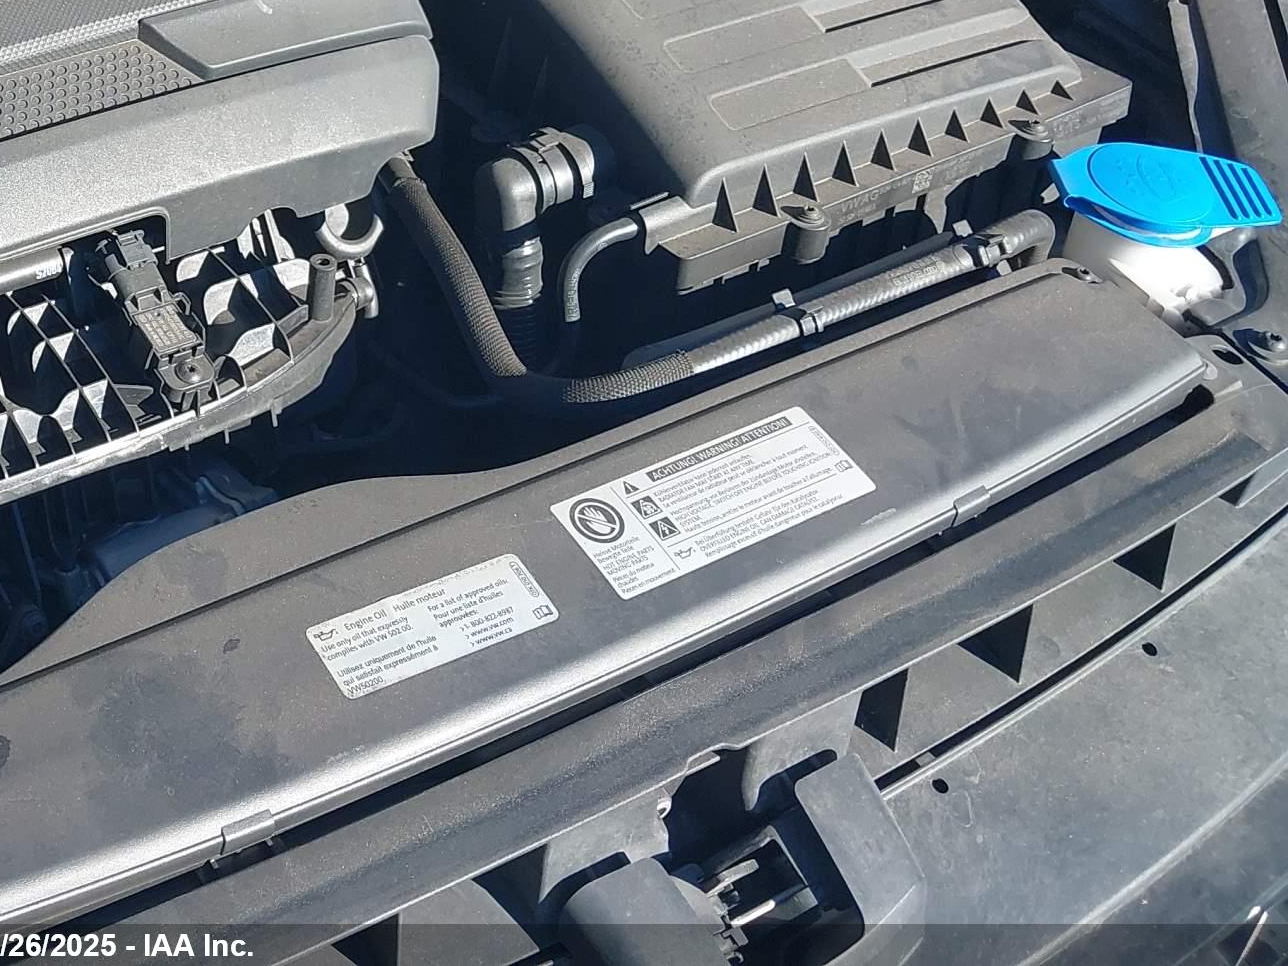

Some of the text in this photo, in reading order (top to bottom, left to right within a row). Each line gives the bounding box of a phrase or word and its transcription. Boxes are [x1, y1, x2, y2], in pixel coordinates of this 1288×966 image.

[697, 440, 741, 461] WARNING!
[742, 420, 788, 443] ATTENTION!
[465, 584, 494, 599] approved
[344, 617, 373, 630] Engine
[374, 610, 387, 619] Oil
[416, 590, 445, 603] moteur
[434, 611, 449, 620] Pour
[321, 644, 336, 652] Use
[337, 639, 351, 647] only
[352, 633, 361, 641] oil
[361, 628, 377, 637] that
[328, 647, 358, 661] complies
[359, 639, 375, 648] with
[375, 634, 387, 642] VW
[337, 664, 364, 677] Utilisez
[365, 648, 405, 666] uniquement
[343, 677, 355, 686] qui
